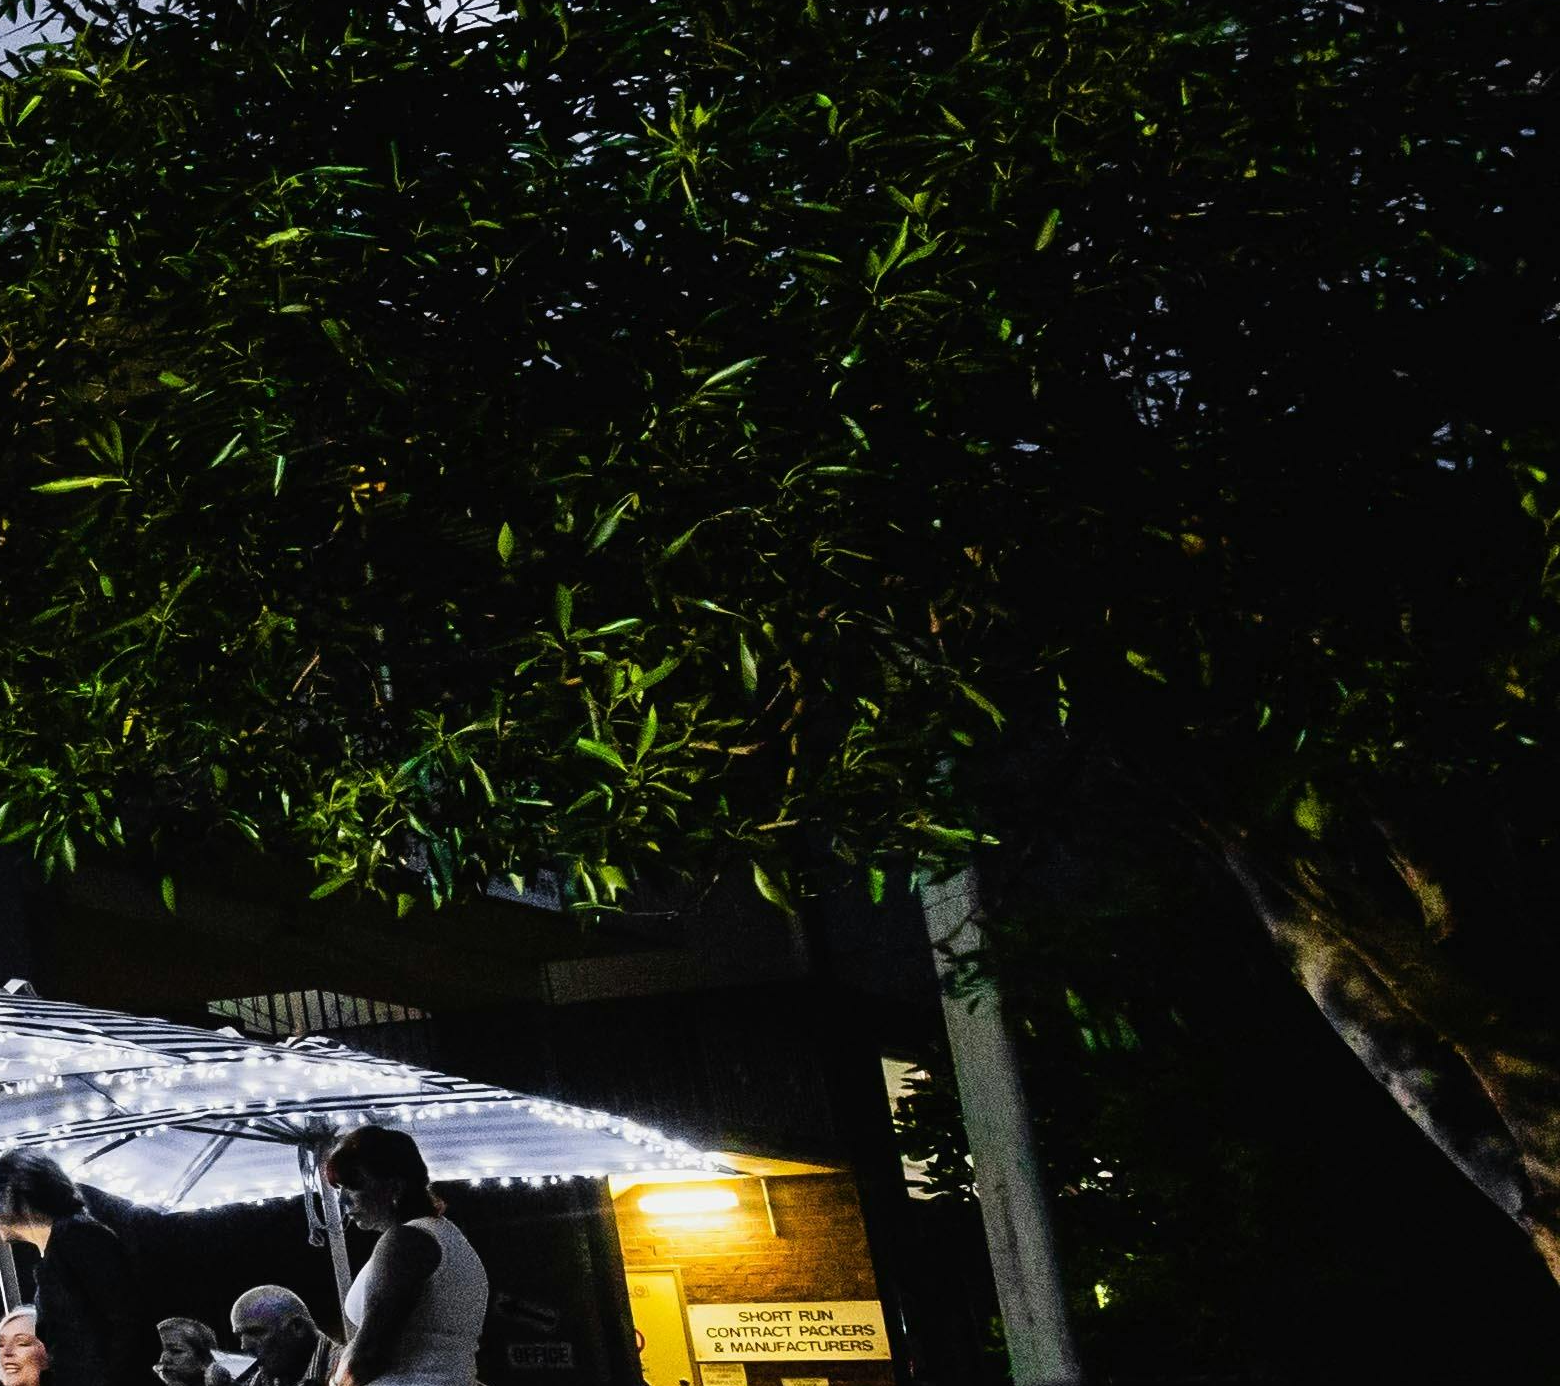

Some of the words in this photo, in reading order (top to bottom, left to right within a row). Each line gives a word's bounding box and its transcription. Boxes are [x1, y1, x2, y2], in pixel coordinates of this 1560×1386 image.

[738, 1310, 793, 1323] SHORT
[799, 1309, 834, 1322] RUN
[706, 1326, 793, 1339] CONTRACT
[799, 1324, 876, 1337] PACKERS
[714, 1341, 724, 1353] &
[730, 1339, 875, 1353] MANUFACTURERS
